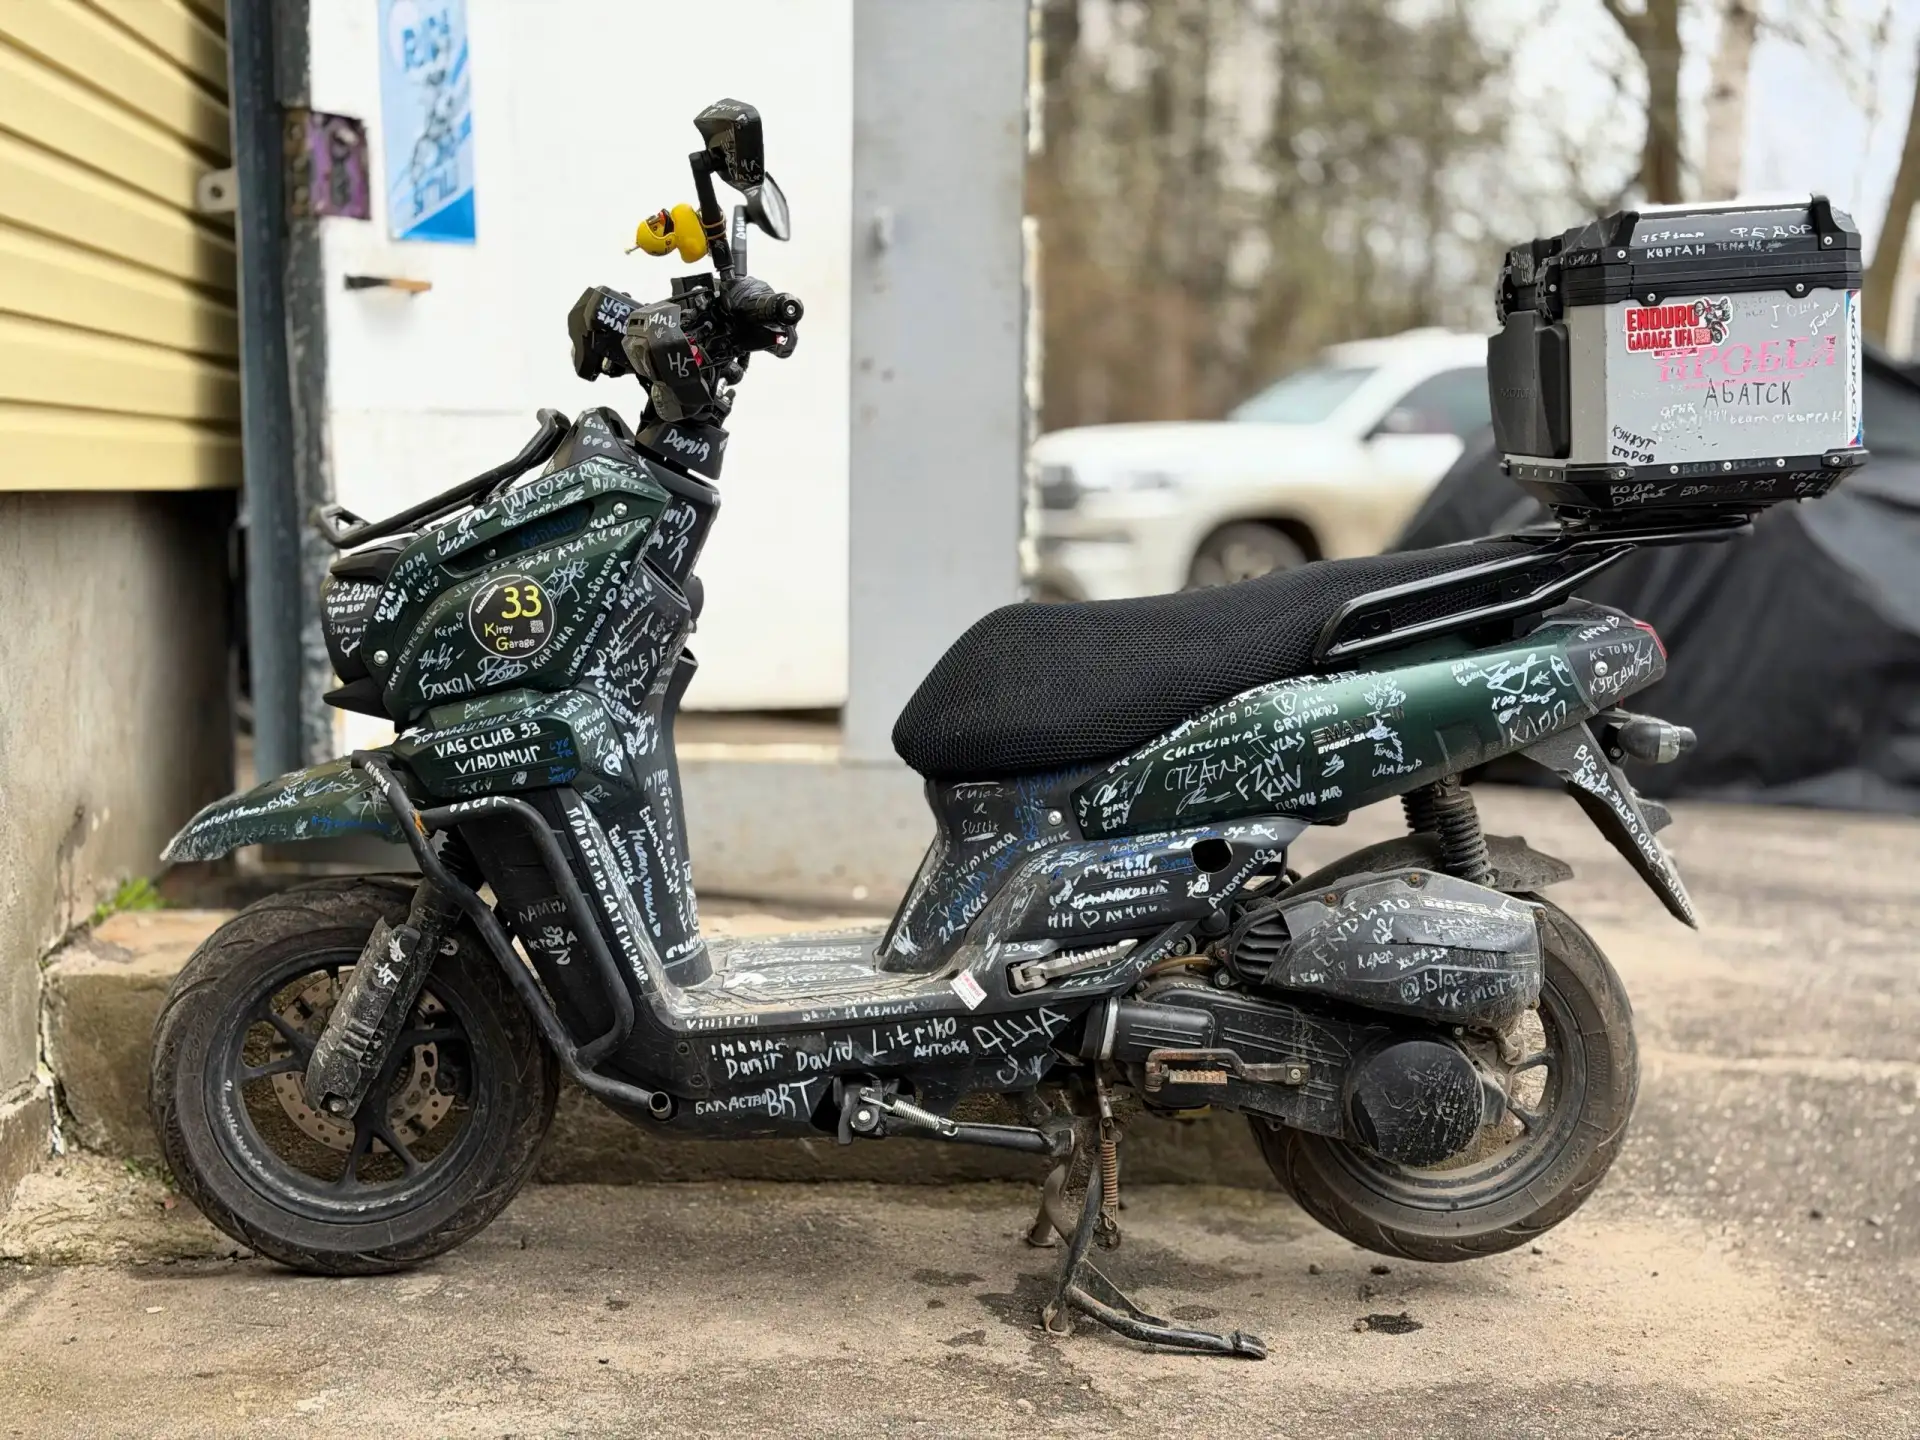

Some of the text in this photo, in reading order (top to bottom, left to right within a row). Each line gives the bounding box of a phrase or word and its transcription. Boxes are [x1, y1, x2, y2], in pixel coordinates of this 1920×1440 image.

[1626, 304, 1700, 332] ENDURO
[1627, 327, 1694, 351] GARAGE UFA
[1702, 378, 1792, 408] АБАТСК
[501, 584, 542, 619] 33
[602, 560, 631, 611] ЮРА
[484, 622, 514, 638] Kirey
[495, 635, 536, 652] Garage
[530, 625, 576, 670] КАРИНА
[434, 739, 469, 759] VAG
[470, 727, 516, 751] CLUB
[520, 721, 542, 739] 33
[566, 806, 601, 868] ПРИВЕТ
[795, 1034, 853, 1072] David
[764, 1076, 818, 1119] BRT
